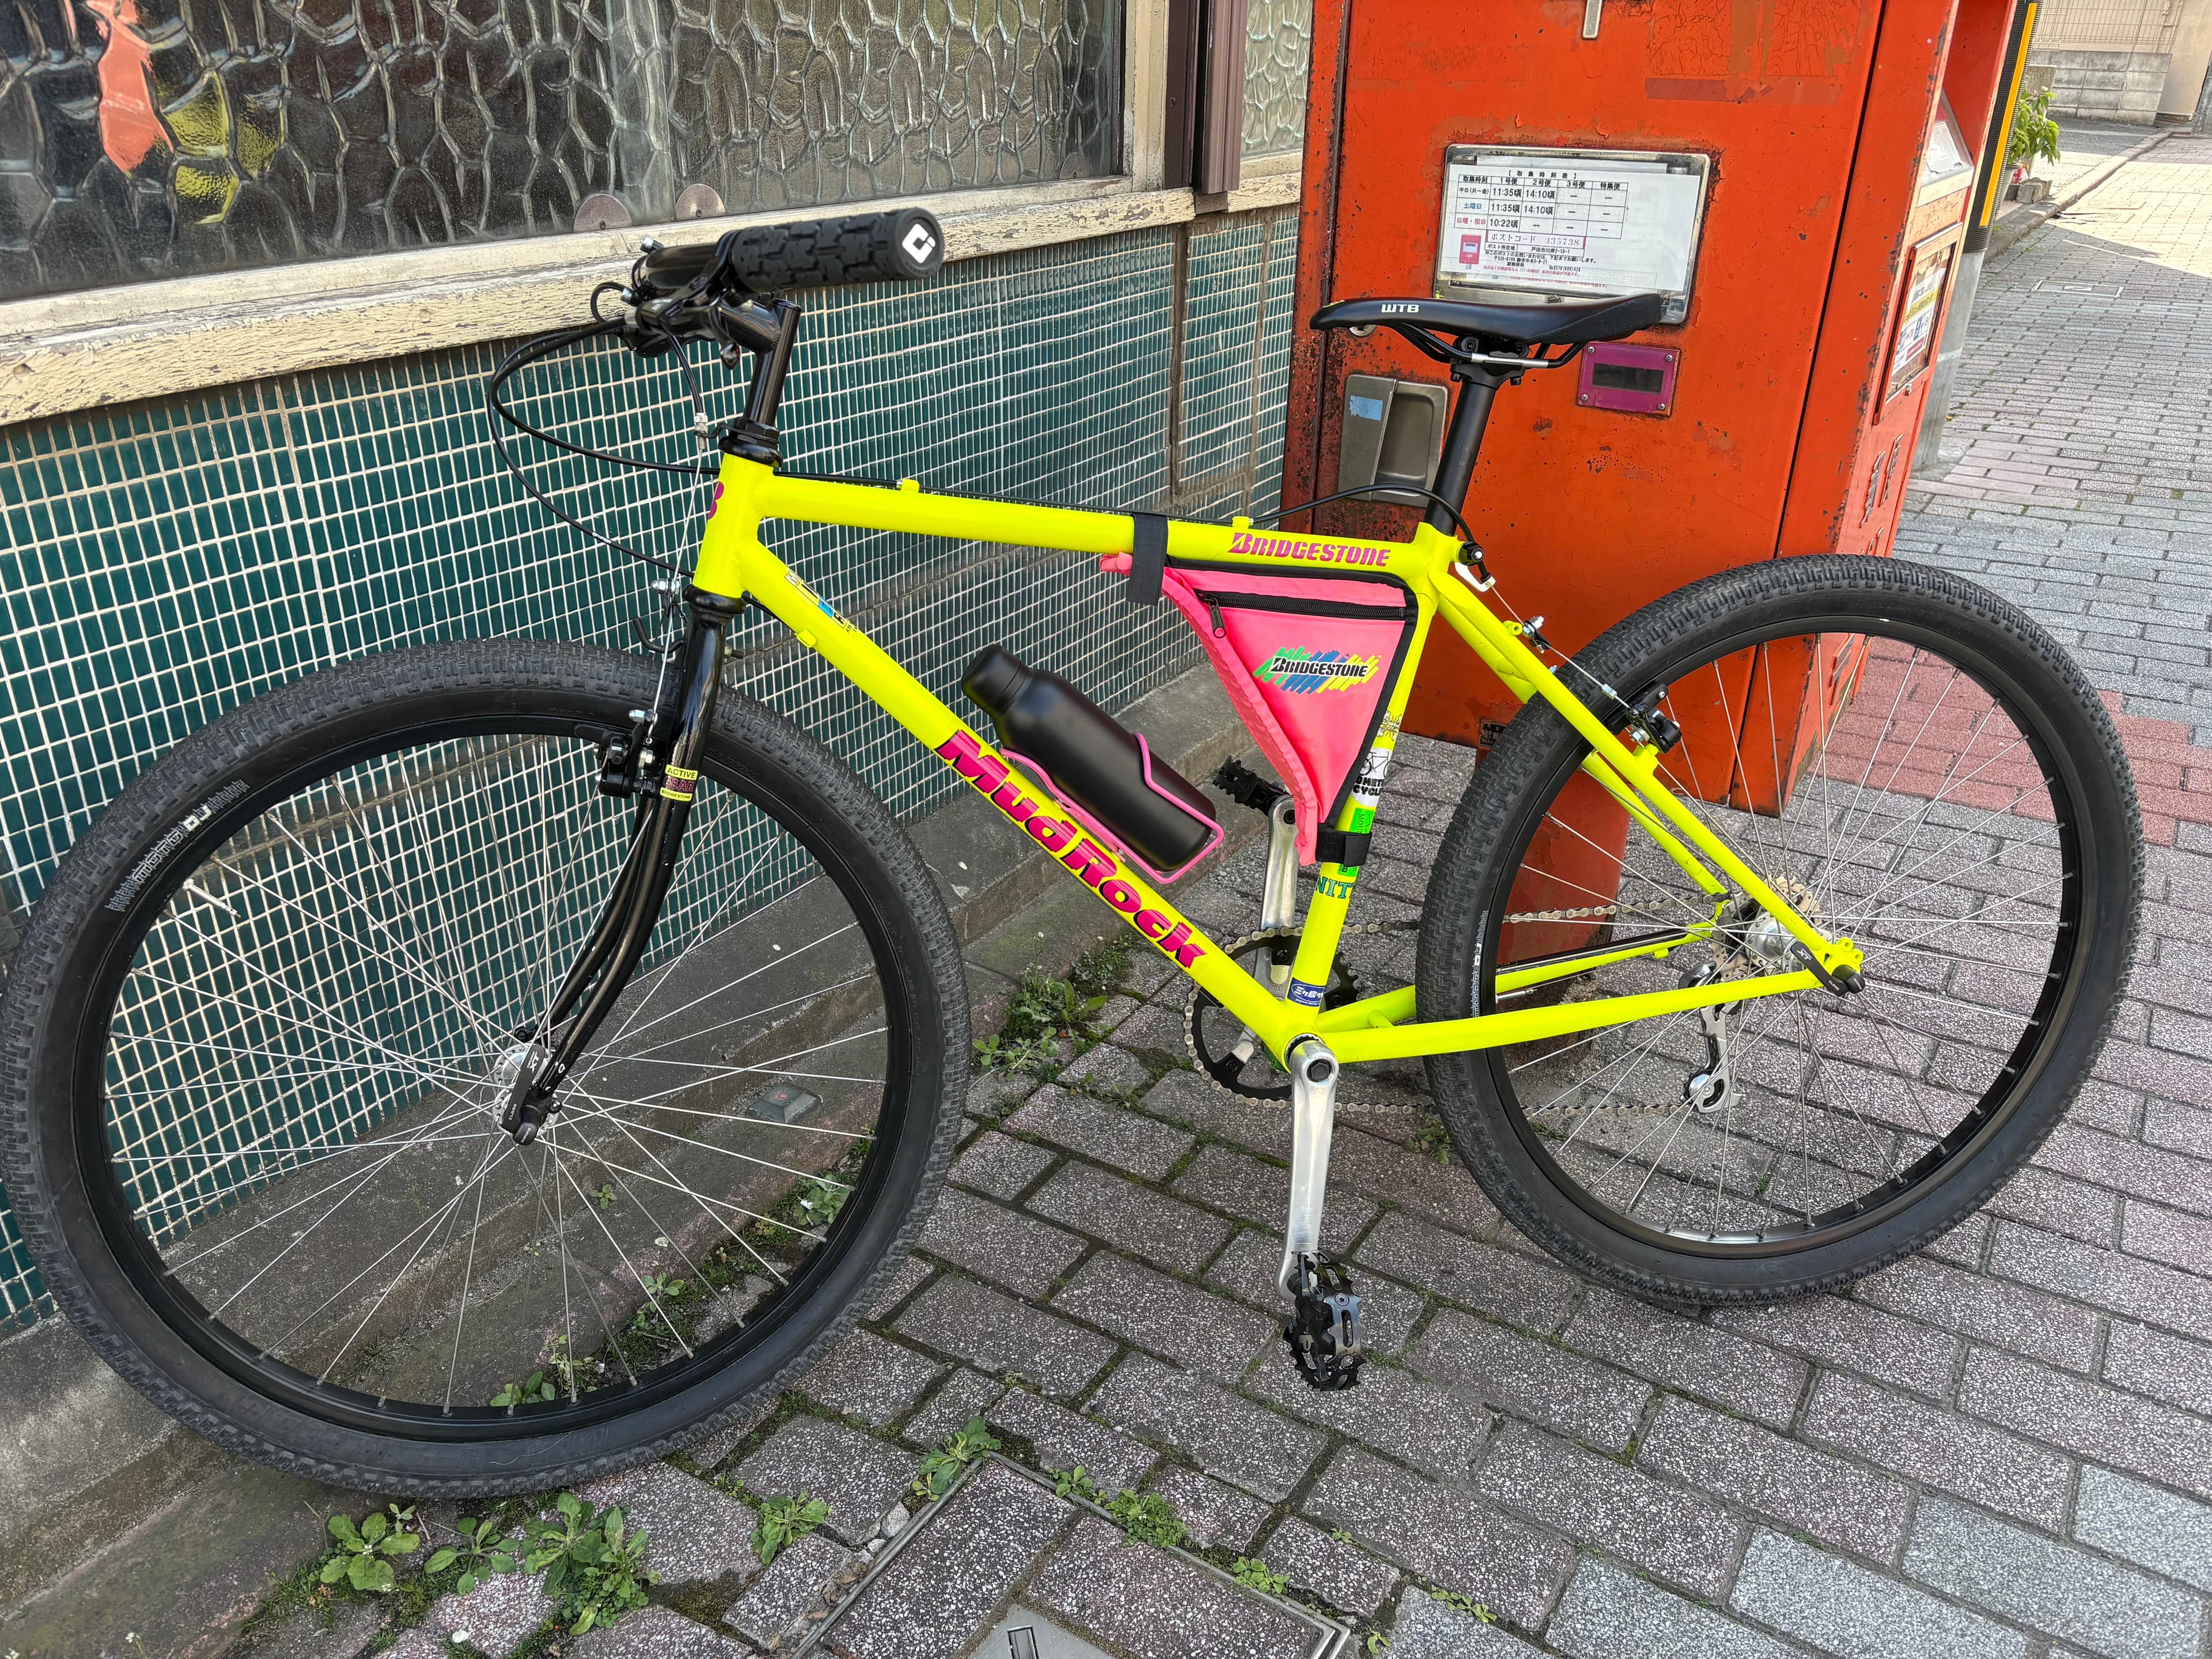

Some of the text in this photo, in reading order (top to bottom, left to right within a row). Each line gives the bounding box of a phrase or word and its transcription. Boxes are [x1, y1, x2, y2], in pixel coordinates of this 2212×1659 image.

[1493, 188, 1522, 198] 11:35頃
[1525, 190, 1555, 199] 14:10頃
[1491, 203, 1520, 213] 11:35頃
[1524, 206, 1554, 215] 14:10頃
[1489, 219, 1518, 228] 10:22頃
[1491, 234, 1580, 247] ポストコード 335738
[1381, 304, 1419, 313] WTB
[1228, 532, 1391, 567] BRIDGESTONE
[1270, 657, 1370, 677] BRIDGESTONE
[667, 767, 696, 779] ACTIVE
[664, 777, 694, 791] GEAR
[1315, 875, 1354, 899] NIT
[509, 1103, 517, 1120] CLOSE
